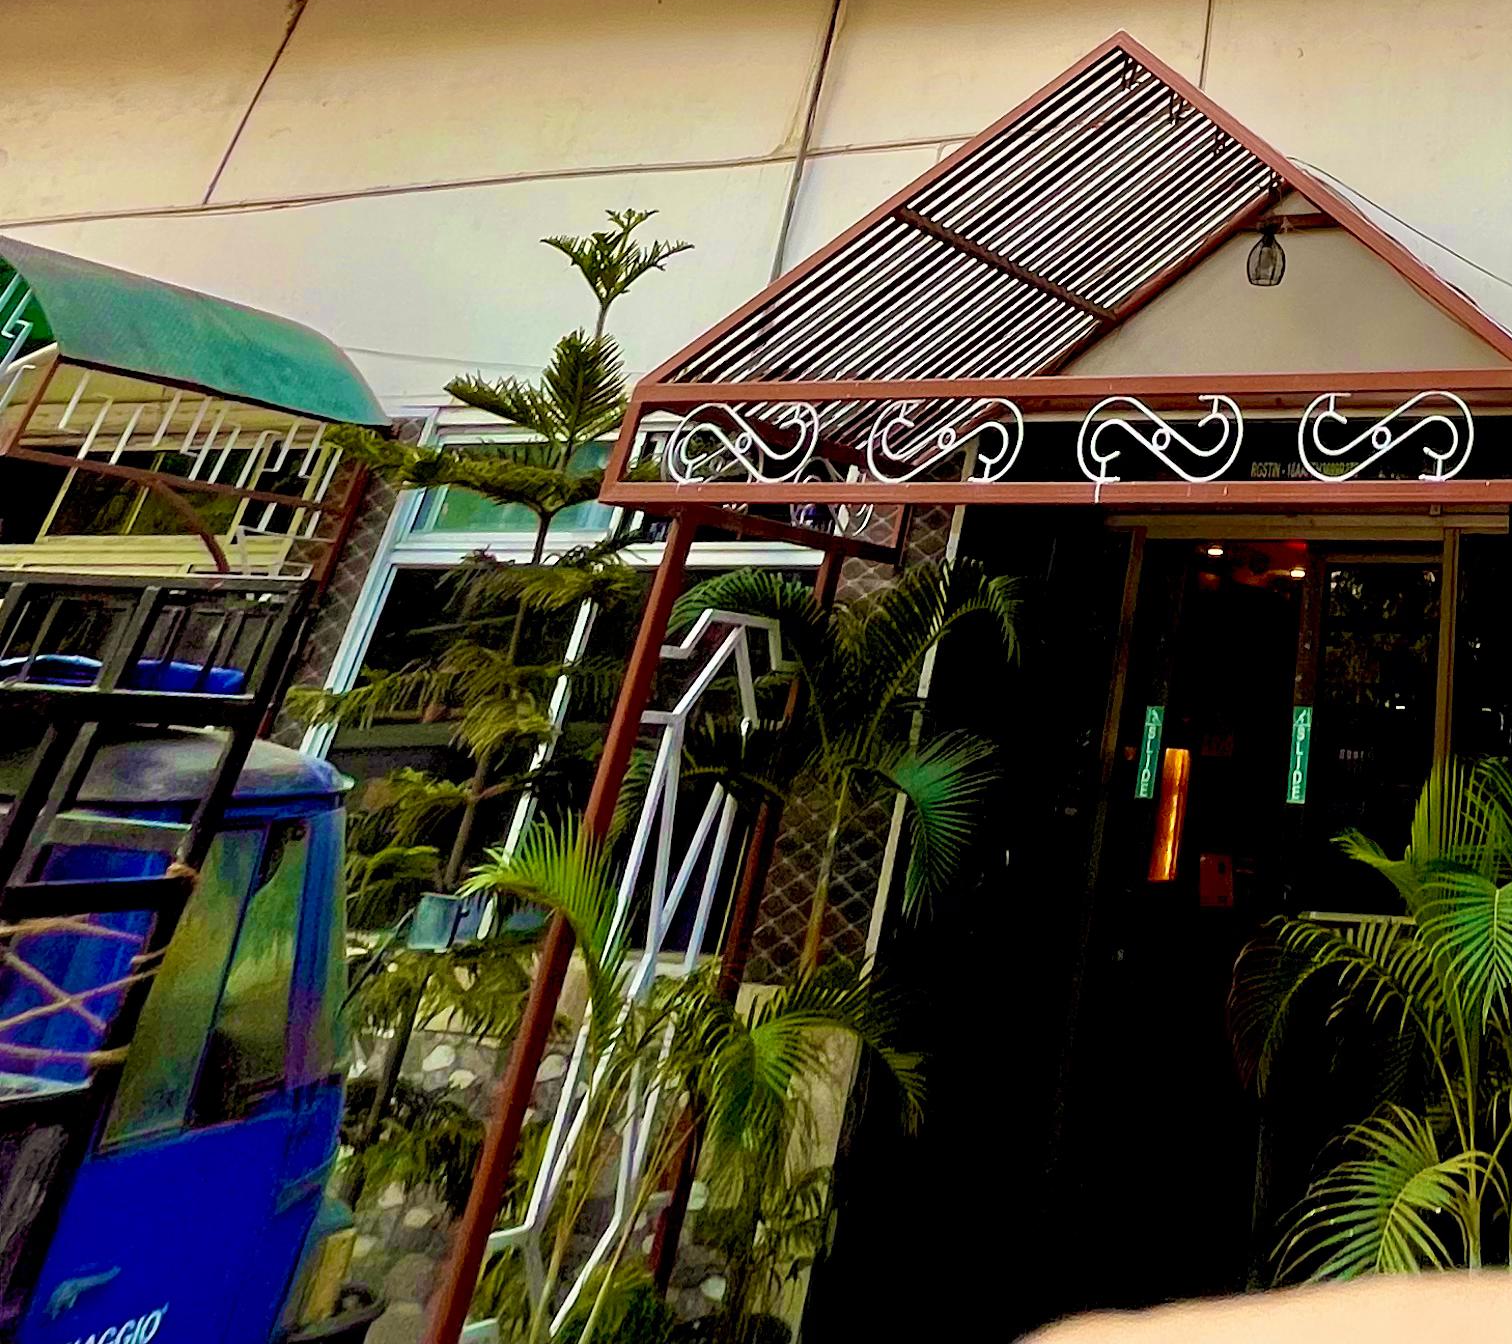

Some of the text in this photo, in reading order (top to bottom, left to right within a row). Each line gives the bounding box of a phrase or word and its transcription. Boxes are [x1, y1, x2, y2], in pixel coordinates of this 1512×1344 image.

[1139, 725, 1156, 798] SLIDE
[1291, 726, 1306, 800] SLIDE
[66, 1308, 163, 1344] GGIO
